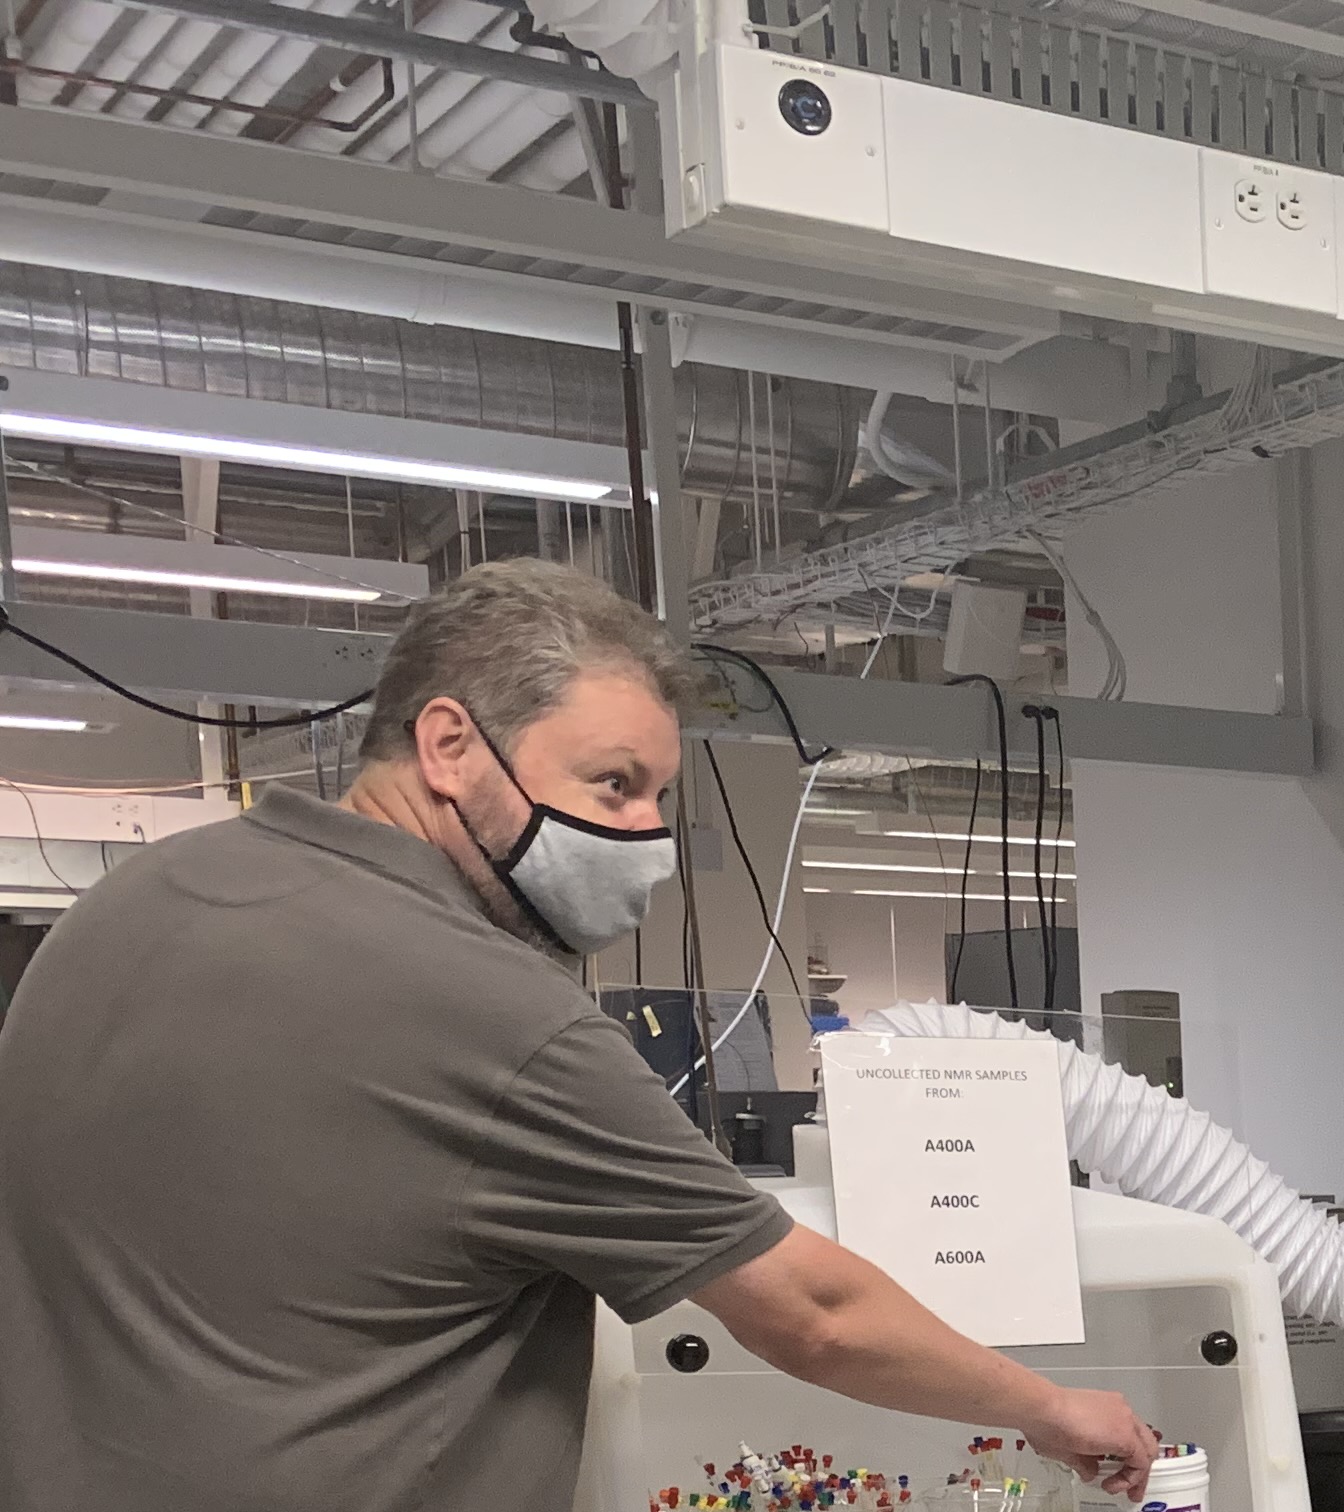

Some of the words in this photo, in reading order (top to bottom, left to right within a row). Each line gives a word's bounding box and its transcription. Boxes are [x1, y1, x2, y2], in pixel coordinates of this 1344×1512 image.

[856, 1068, 941, 1082] UNCOLLECTED
[943, 1069, 973, 1081] NMR
[975, 1069, 1028, 1082] SAMPLES
[925, 1087, 964, 1099] FROM:
[924, 1139, 976, 1154] A400A
[930, 1194, 980, 1209] A400C
[934, 1250, 986, 1265] A600A
